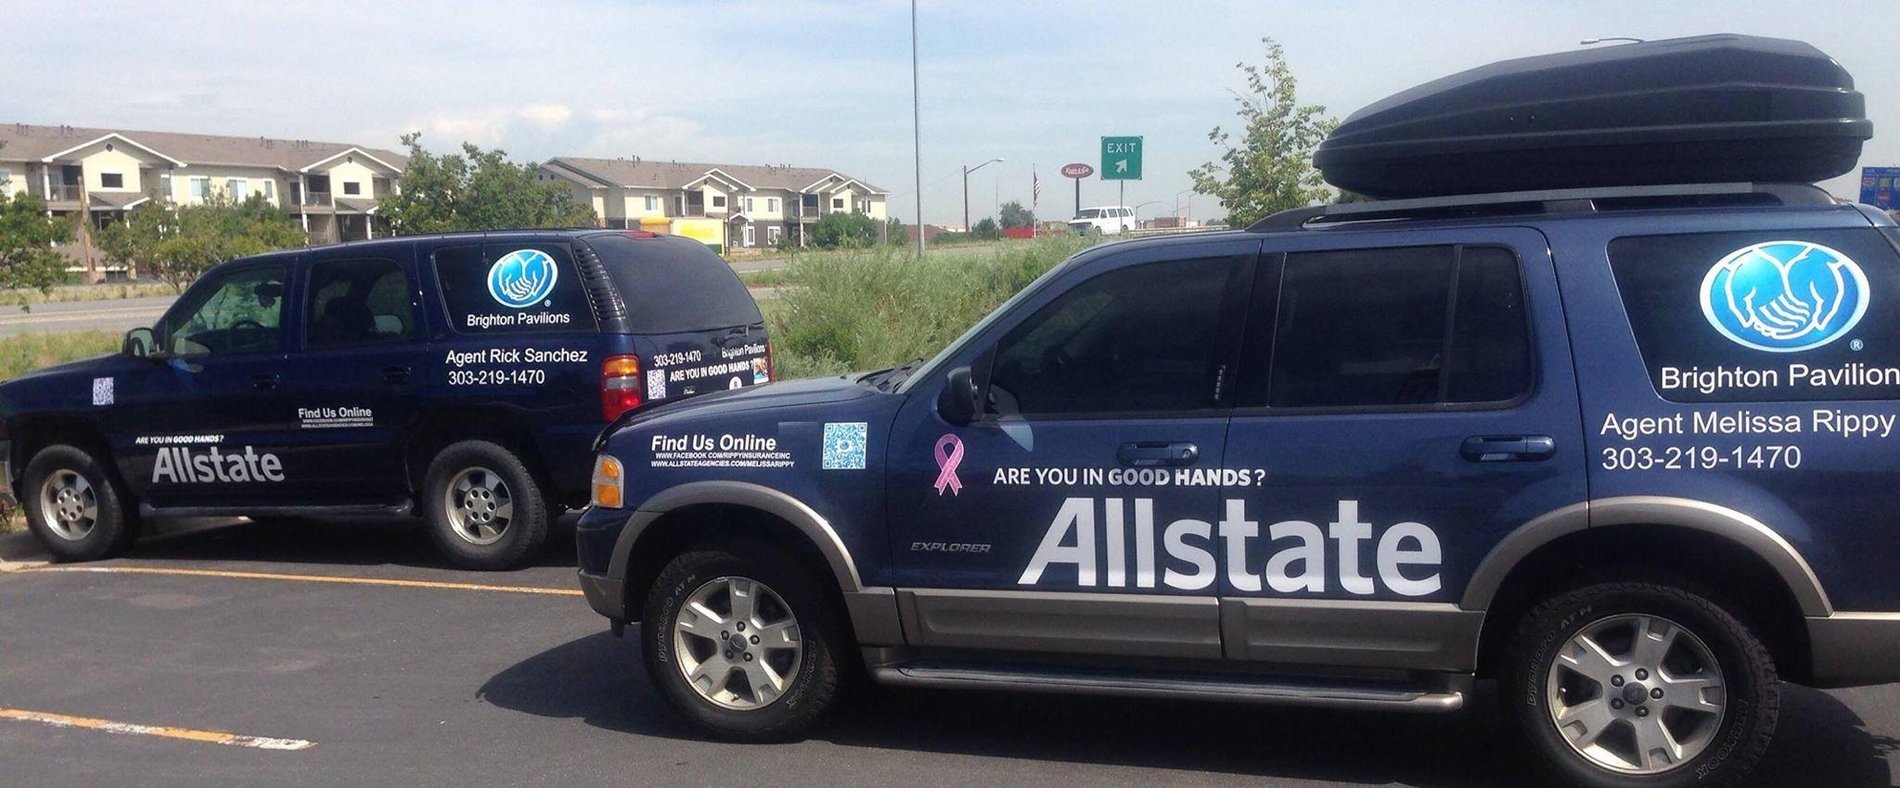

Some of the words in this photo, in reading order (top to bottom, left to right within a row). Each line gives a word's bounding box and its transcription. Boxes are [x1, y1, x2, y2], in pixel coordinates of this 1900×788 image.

[1107, 143, 1136, 154] EXIT
[467, 315, 514, 329] Brighton
[518, 312, 570, 325] Pavilions
[446, 350, 486, 367] Agent
[490, 349, 520, 362] Rick
[524, 348, 588, 362] Sanchez
[653, 350, 702, 368] 303-219-1470
[721, 347, 744, 360] Brighton
[744, 343, 766, 355] Pavilions
[448, 370, 545, 385] 303-219-1470
[670, 370, 685, 382] ARE
[685, 368, 700, 380] YOU
[700, 366, 708, 377] IN
[708, 364, 728, 376] GOOD
[728, 361, 750, 373] HANDS
[1661, 366, 1778, 394] Brighton
[1789, 363, 1900, 387] Pavilion
[298, 408, 320, 419] Find
[323, 407, 336, 418] Us
[339, 407, 372, 417] Online
[1600, 413, 1683, 440] Agent
[1694, 411, 1801, 434] Melissa
[1813, 410, 1895, 438] Rippy
[150, 436, 163, 444] YOU
[173, 435, 194, 443] GOOD
[194, 435, 219, 443] HANDS
[651, 436, 687, 451] Find
[693, 434, 714, 450] Us
[719, 434, 776, 450] Online
[152, 446, 285, 483] Allstate
[1602, 446, 1801, 470] 303-219-1470
[993, 468, 1030, 485] ARE
[1035, 468, 1078, 485] YOU
[1083, 468, 1103, 485] IN
[1107, 468, 1170, 486] GOOD
[1175, 469, 1251, 486] HANDS
[910, 542, 992, 553] EXPLORER
[1017, 497, 1442, 597] Allstate
